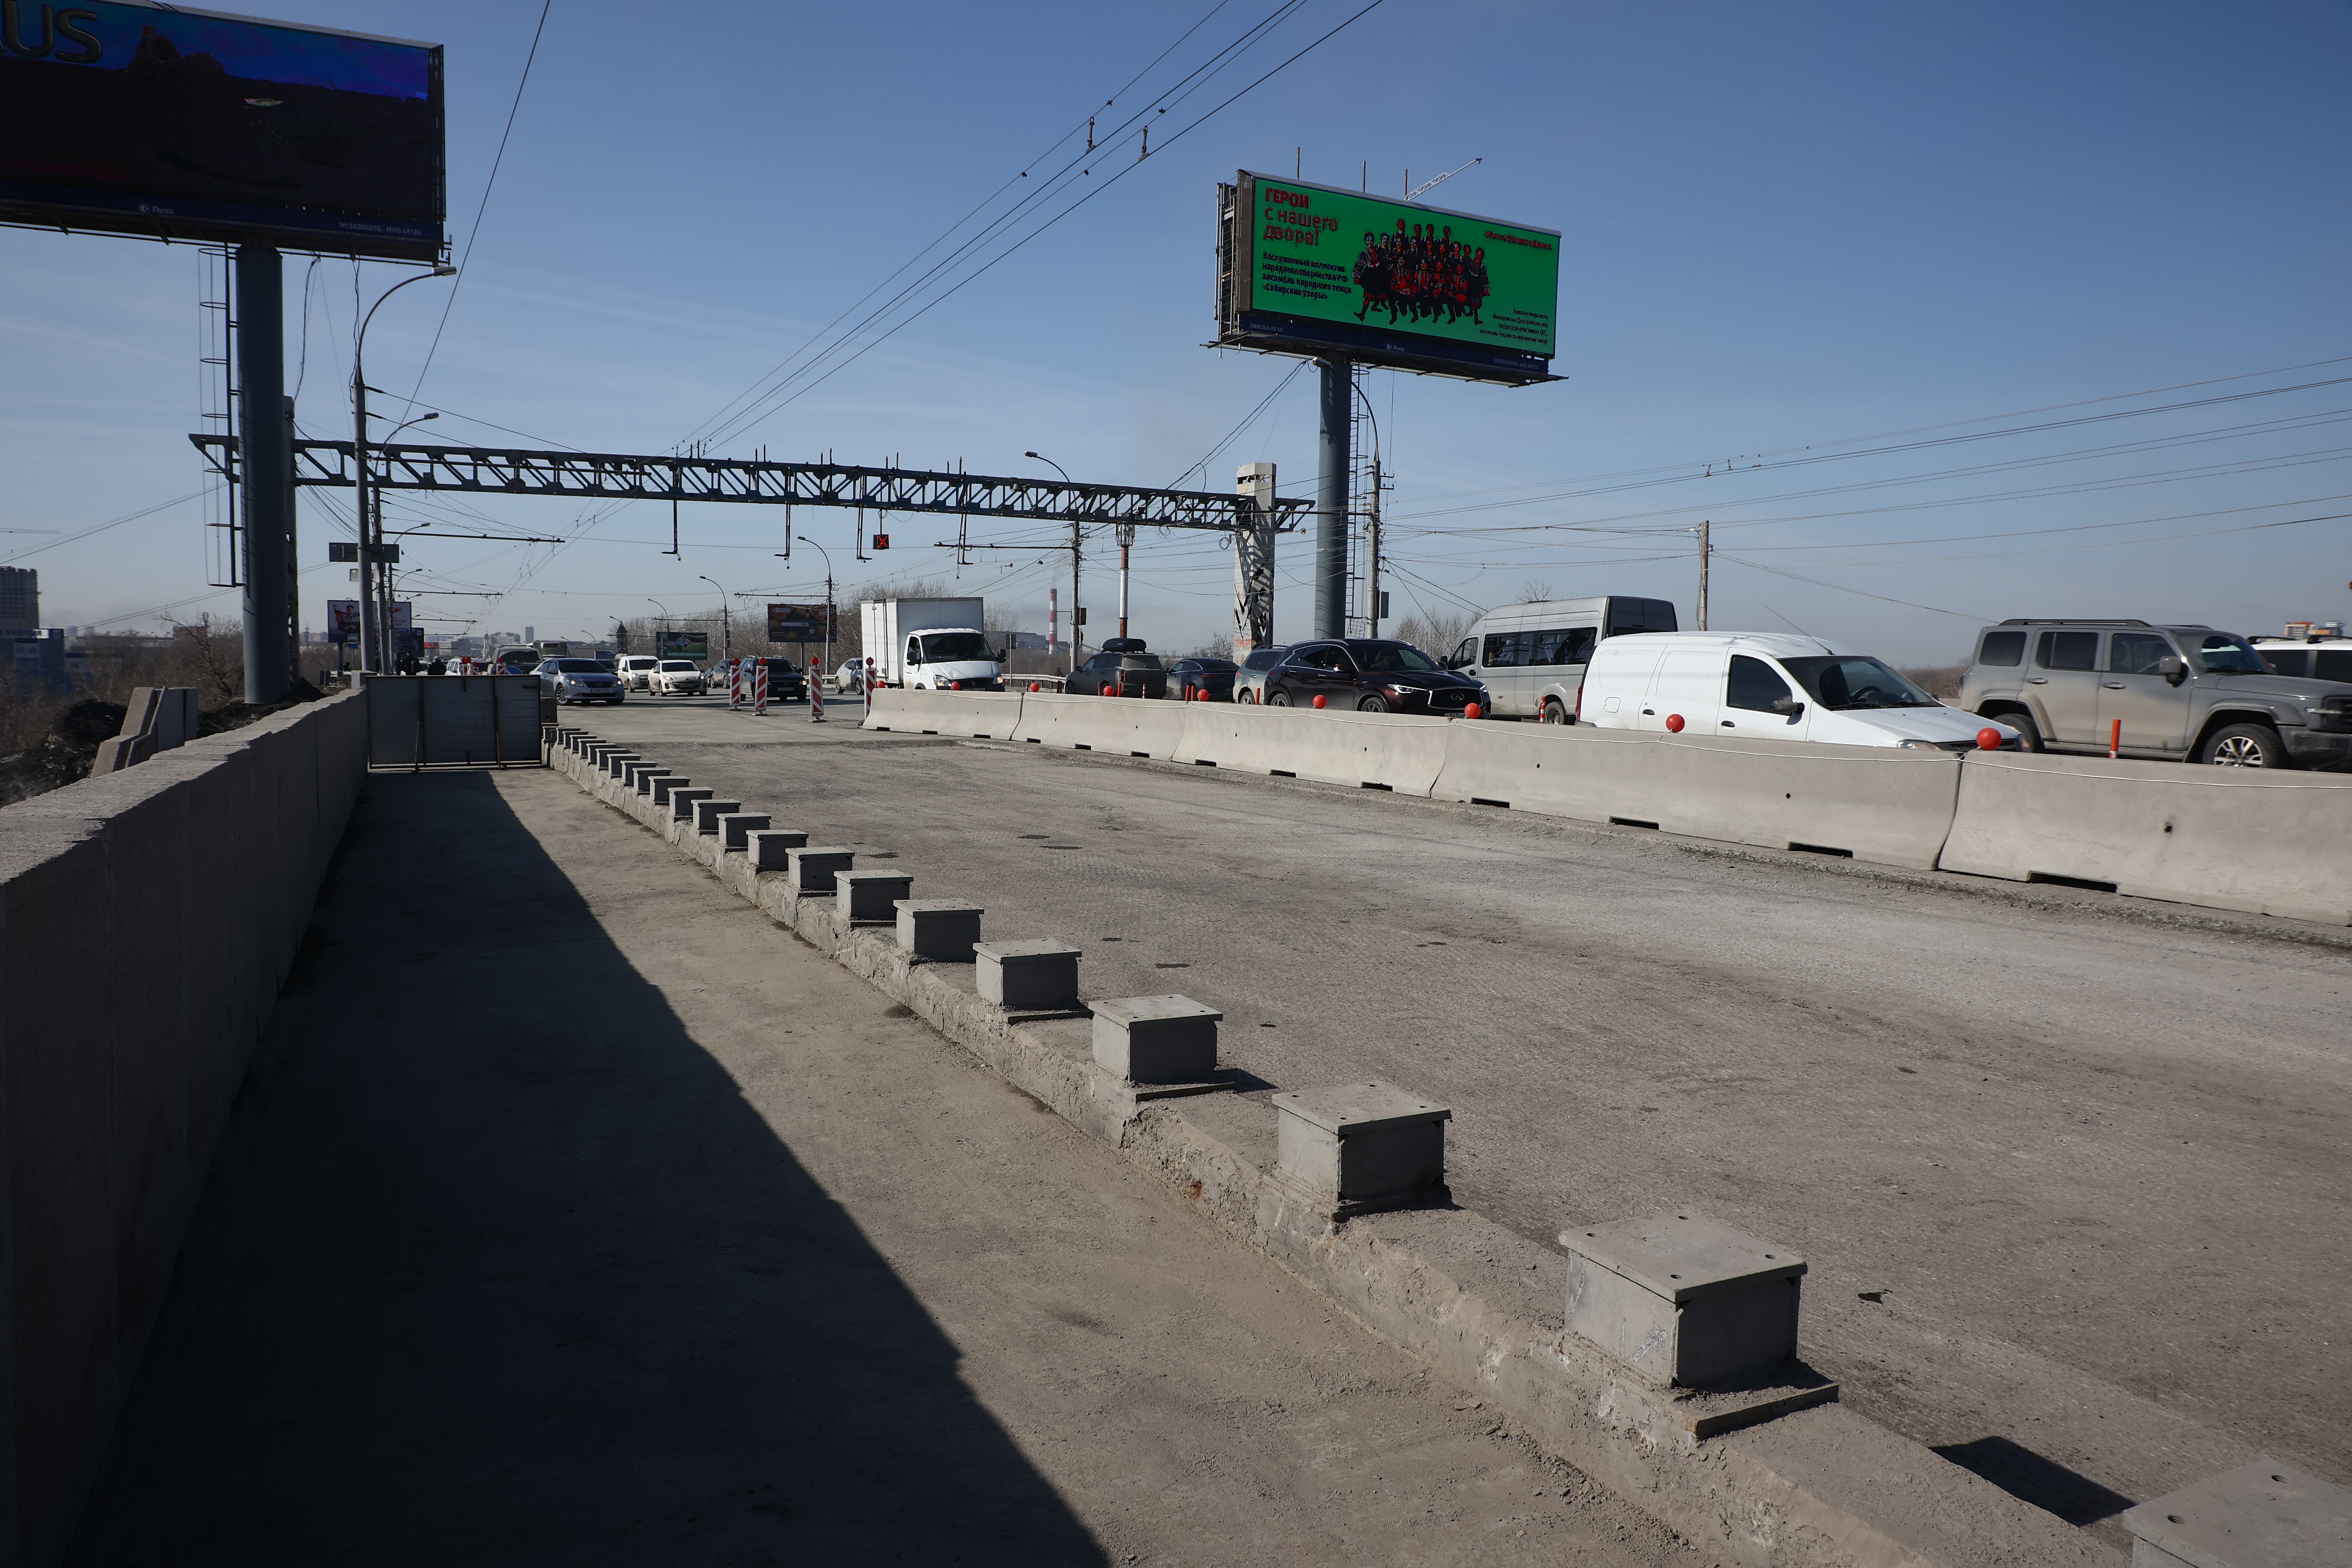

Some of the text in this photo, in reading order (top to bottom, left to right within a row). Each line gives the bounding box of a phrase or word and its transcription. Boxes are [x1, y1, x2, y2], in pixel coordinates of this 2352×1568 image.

[1266, 187, 1310, 208] ГЕРОИ
[152, 205, 175, 214] Russ
[1278, 209, 1338, 231] нашего
[1264, 225, 1319, 249] двора!
[1263, 251, 1346, 273] Заслуженный коллектив
[1262, 263, 1348, 282] народного творчества РФ
[1262, 274, 1352, 294] ансамбль народного танца
[1262, 283, 1328, 300] «Сибирские узоры»
